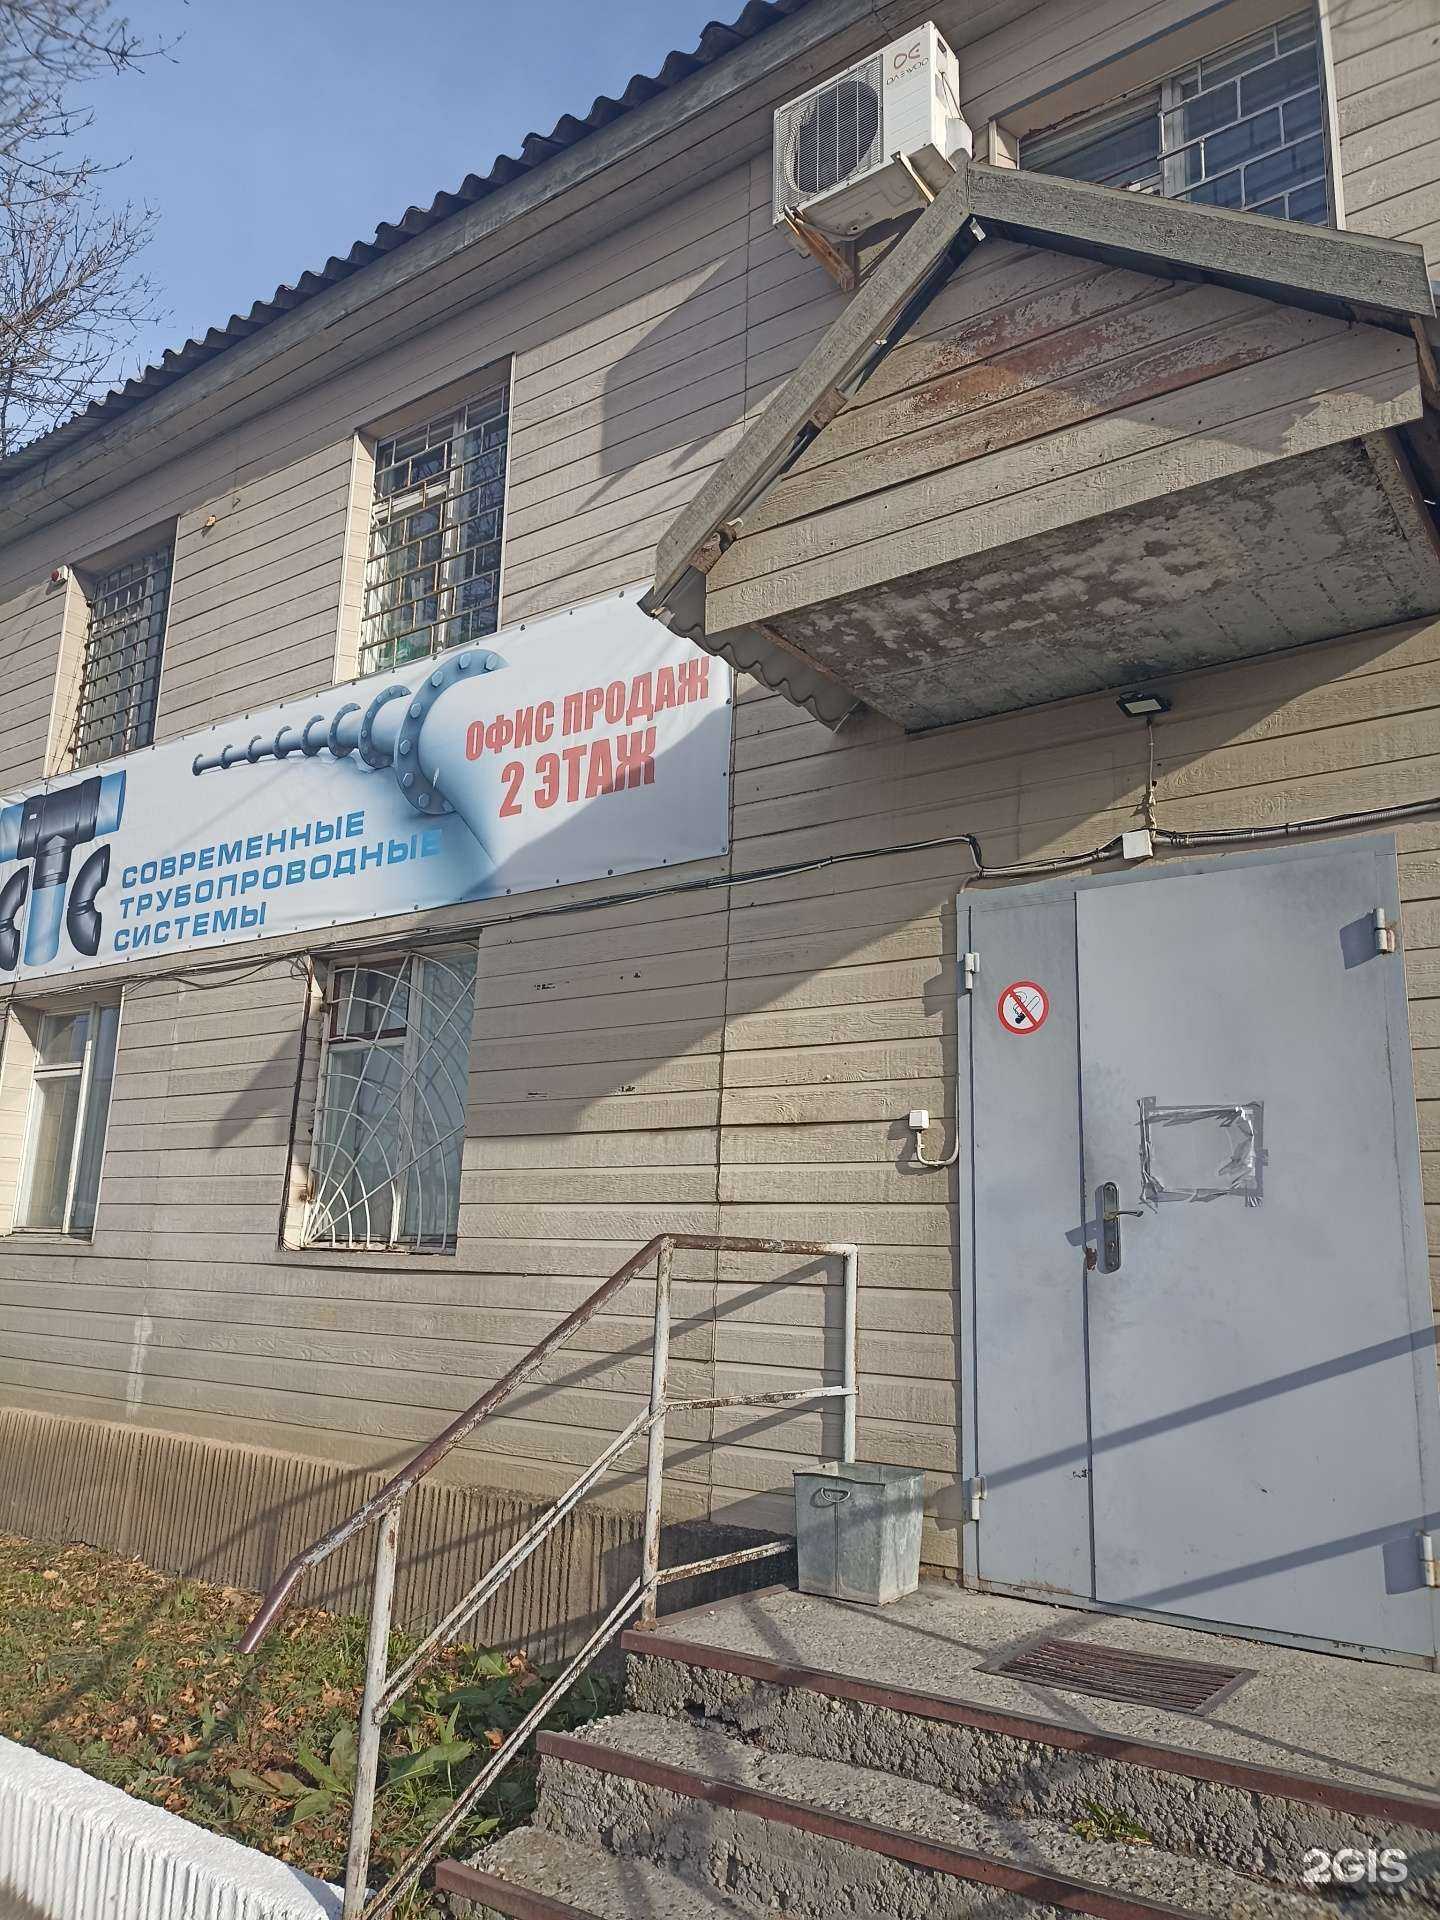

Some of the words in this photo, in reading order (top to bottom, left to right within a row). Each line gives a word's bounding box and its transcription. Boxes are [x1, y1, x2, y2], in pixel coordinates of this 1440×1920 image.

[465, 700, 555, 762] ОФИС
[561, 655, 711, 737] ПРОДАЖ
[499, 760, 525, 819] 2
[534, 725, 657, 809] ЭТАЖ
[118, 828, 445, 920] ТРУБОПРОВОДНЫЕ
[121, 810, 366, 890] СОВРЕМЕННЫЕ
[113, 900, 268, 953] СИСТЕМЫ
